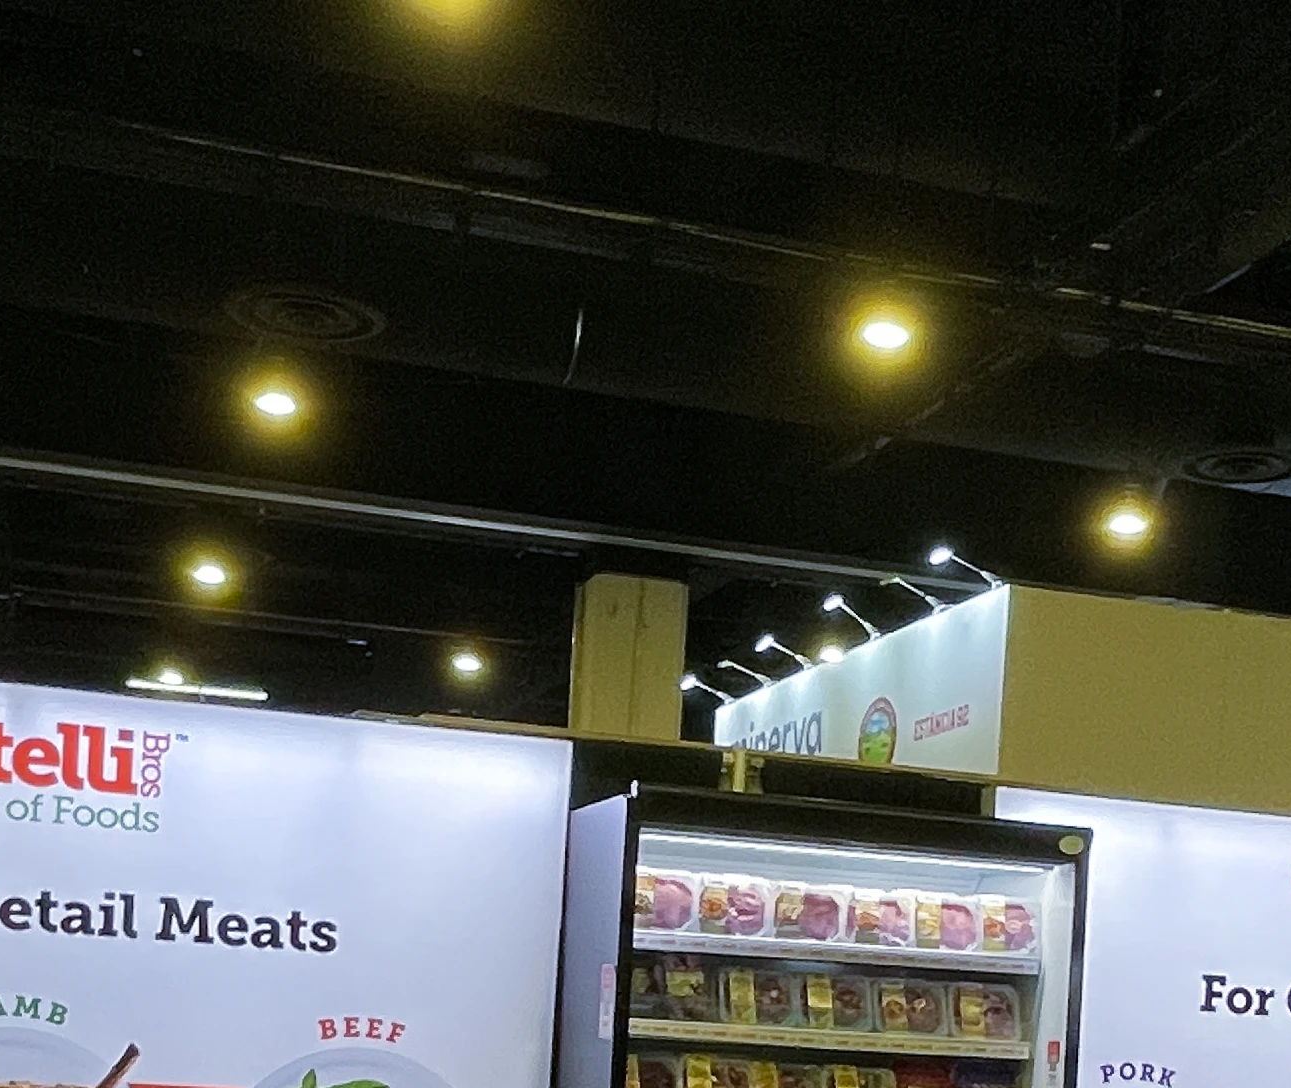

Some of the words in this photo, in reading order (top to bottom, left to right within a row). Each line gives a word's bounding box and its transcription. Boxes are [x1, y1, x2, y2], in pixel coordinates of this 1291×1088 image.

[140, 730, 171, 798] Bros
[5, 796, 43, 822] of
[52, 796, 160, 832] Foods
[155, 897, 338, 953] Meats
[1200, 974, 1276, 1017] For
[318, 1016, 407, 1043] BEEF
[1099, 1062, 1178, 1088] PORK
